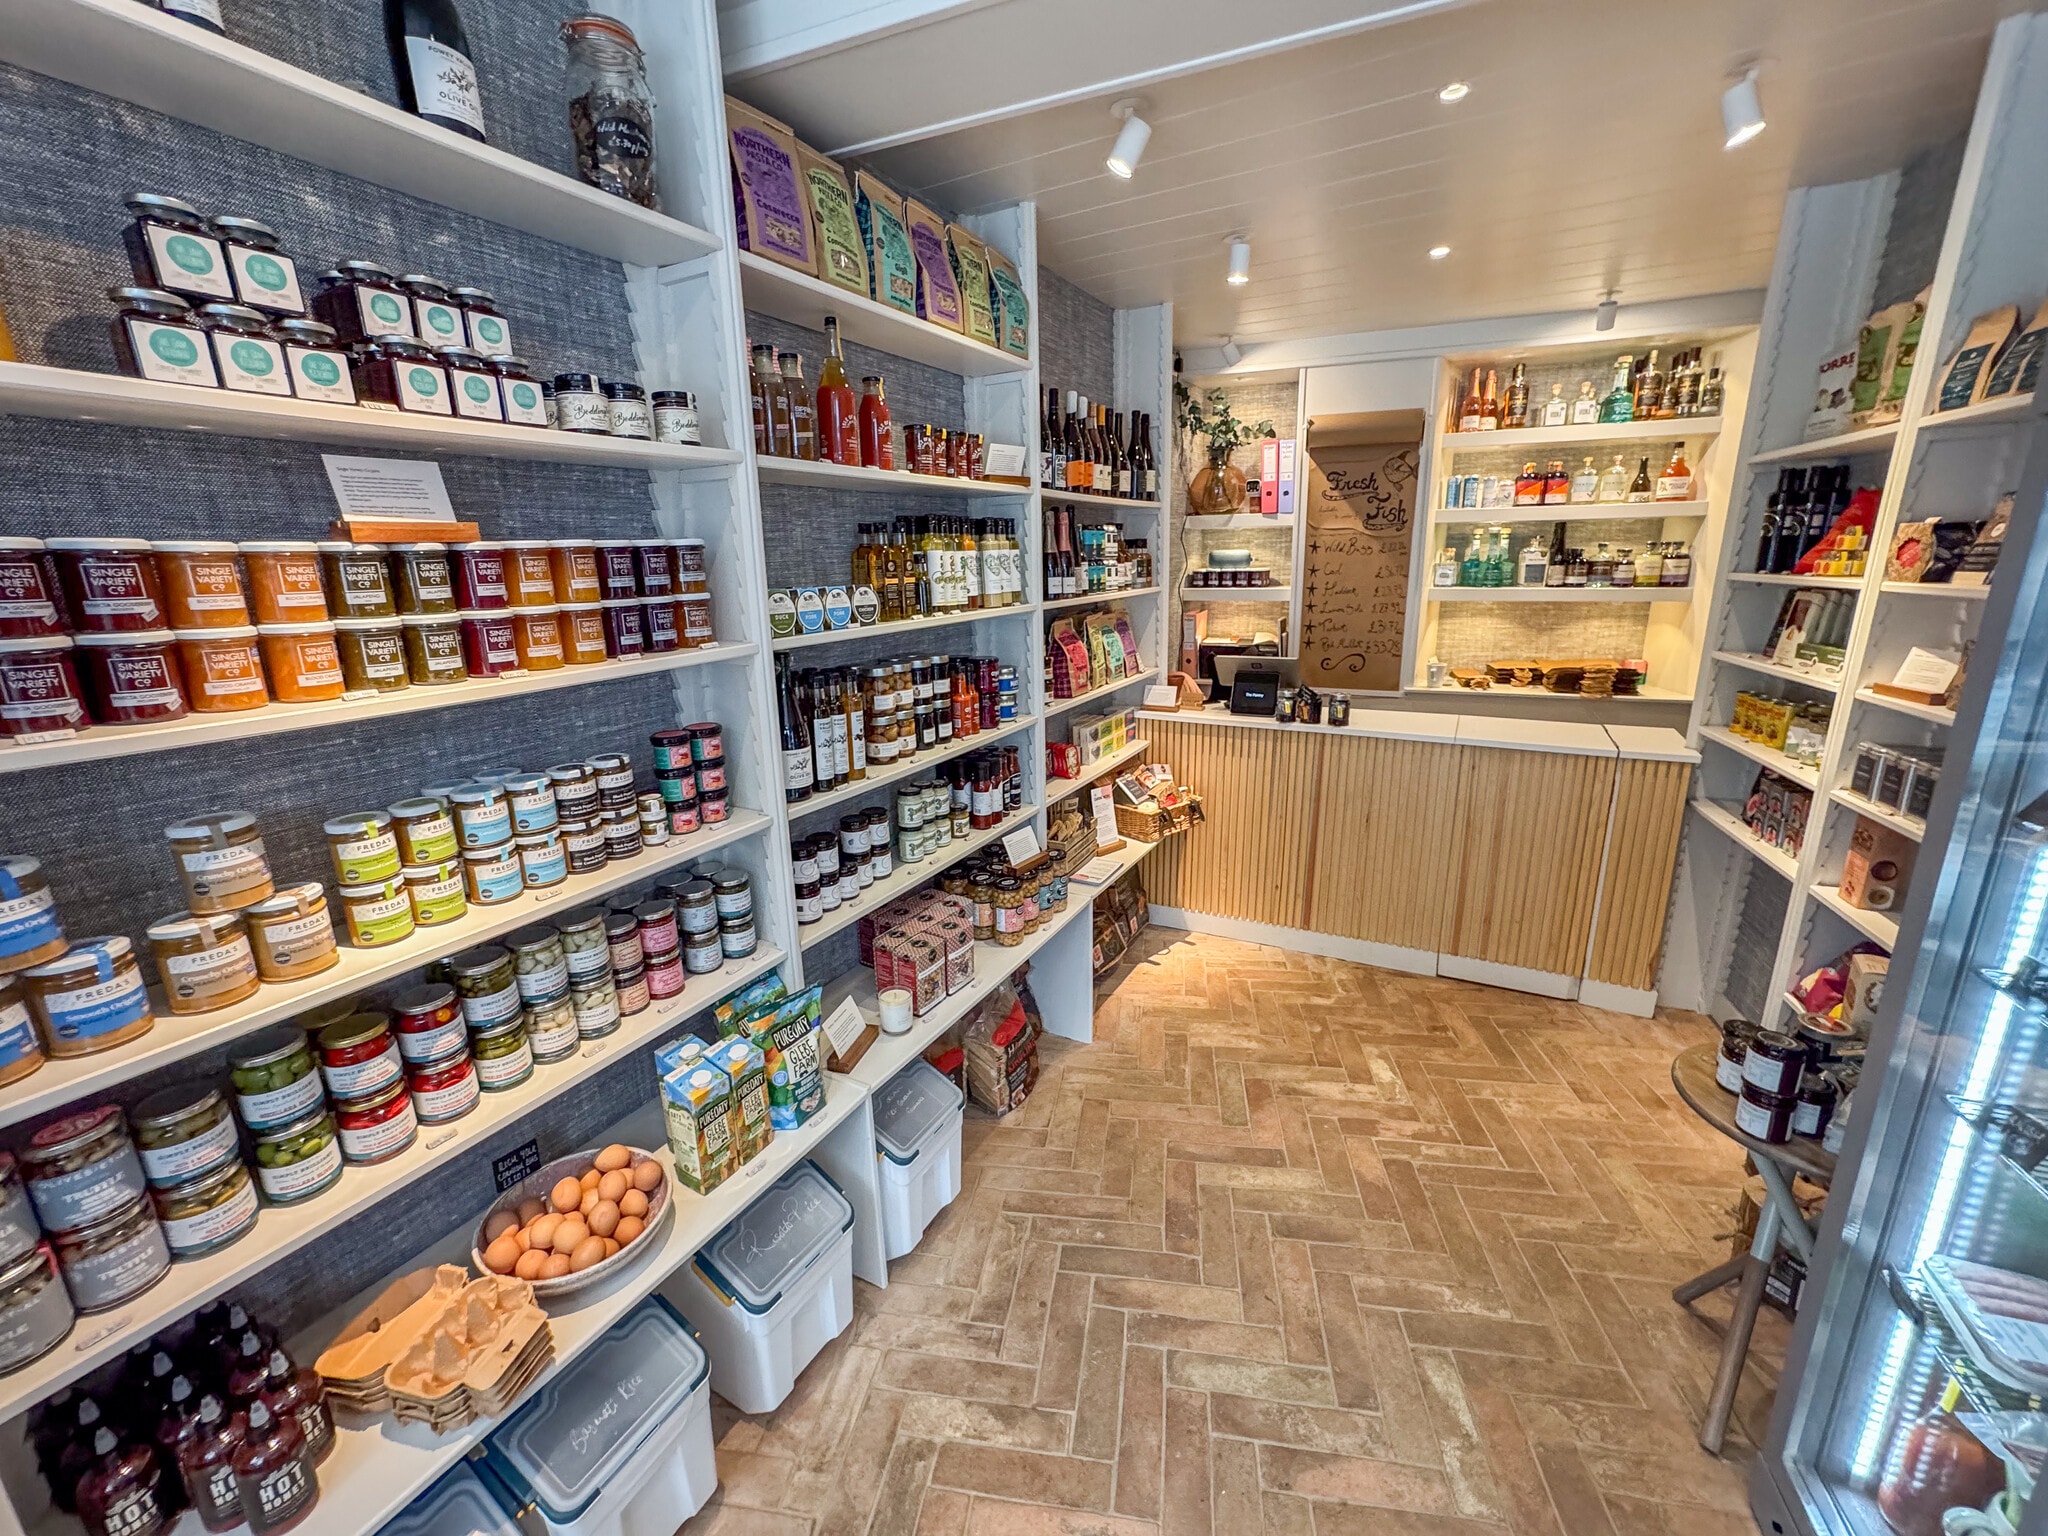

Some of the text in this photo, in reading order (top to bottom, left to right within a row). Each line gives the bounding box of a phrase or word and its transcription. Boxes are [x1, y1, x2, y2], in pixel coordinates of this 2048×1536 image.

[439, 91, 466, 107] OLIVE
[733, 130, 791, 171] NORTHERN
[746, 150, 771, 167] PASTA
[806, 172, 849, 206] NORTHERN
[1326, 470, 1379, 491] Fresh
[1366, 492, 1408, 524] Fish
[0, 568, 33, 577] NGLE
[90, 568, 134, 577] SINGLE
[197, 567, 232, 576] SINGLE
[285, 566, 315, 574] SINGLE
[346, 566, 377, 574] SINGLE
[419, 570, 446, 578] VARIETY
[420, 563, 445, 571] SINGLE
[0, 578, 35, 587] ARIETY
[90, 577, 137, 586] VARIETY
[197, 575, 233, 584] VARIETY
[285, 574, 317, 582] VARIETY
[346, 573, 379, 581] VARIETY
[429, 634, 454, 642] SINGLE
[489, 629, 510, 637] SINGLE
[305, 646, 333, 655] SINGLE
[367, 640, 395, 649] SINGLE
[367, 647, 397, 656] VARIETY
[428, 641, 456, 649] VARIETY
[211, 652, 246, 661] SINGLE
[304, 653, 335, 662] VARIETY
[118, 660, 160, 671] SINGLE
[211, 660, 248, 669] VARIETY
[8, 669, 57, 680] SINGLE
[118, 669, 162, 680] VARIETY
[8, 678, 59, 689] VARIETY
[356, 837, 392, 851] FREDA'S
[204, 846, 252, 862] FREDA'S
[196, 869, 235, 881] Crunchy
[0, 895, 43, 914] REDA'S
[371, 898, 406, 914] FREDA'S
[288, 914, 326, 933] FREDA'S
[278, 939, 313, 951] Crunchy
[191, 945, 239, 964] FREDA'S
[180, 970, 220, 983] Crunchy
[75, 978, 131, 1002] FREDA'S
[65, 992, 143, 1023] Smooth Original
[773, 1014, 810, 1050] PUREOATY
[789, 1039, 816, 1065] GLEBE
[793, 1052, 817, 1079] FARM
[737, 1073, 765, 1100] PUREOATY
[743, 1091, 762, 1110] GLEBE
[699, 1100, 730, 1128] PUREOATY
[744, 1101, 764, 1121] FARM
[706, 1119, 727, 1139] GLEBE
[707, 1129, 729, 1149] FARM
[782, 1196, 822, 1222] Rice
[617, 1374, 644, 1400] Rice
[302, 1405, 323, 1434] OT
[259, 1463, 302, 1504] HOT
[262, 1477, 305, 1512] HONEY
[105, 1492, 155, 1534] HOT
